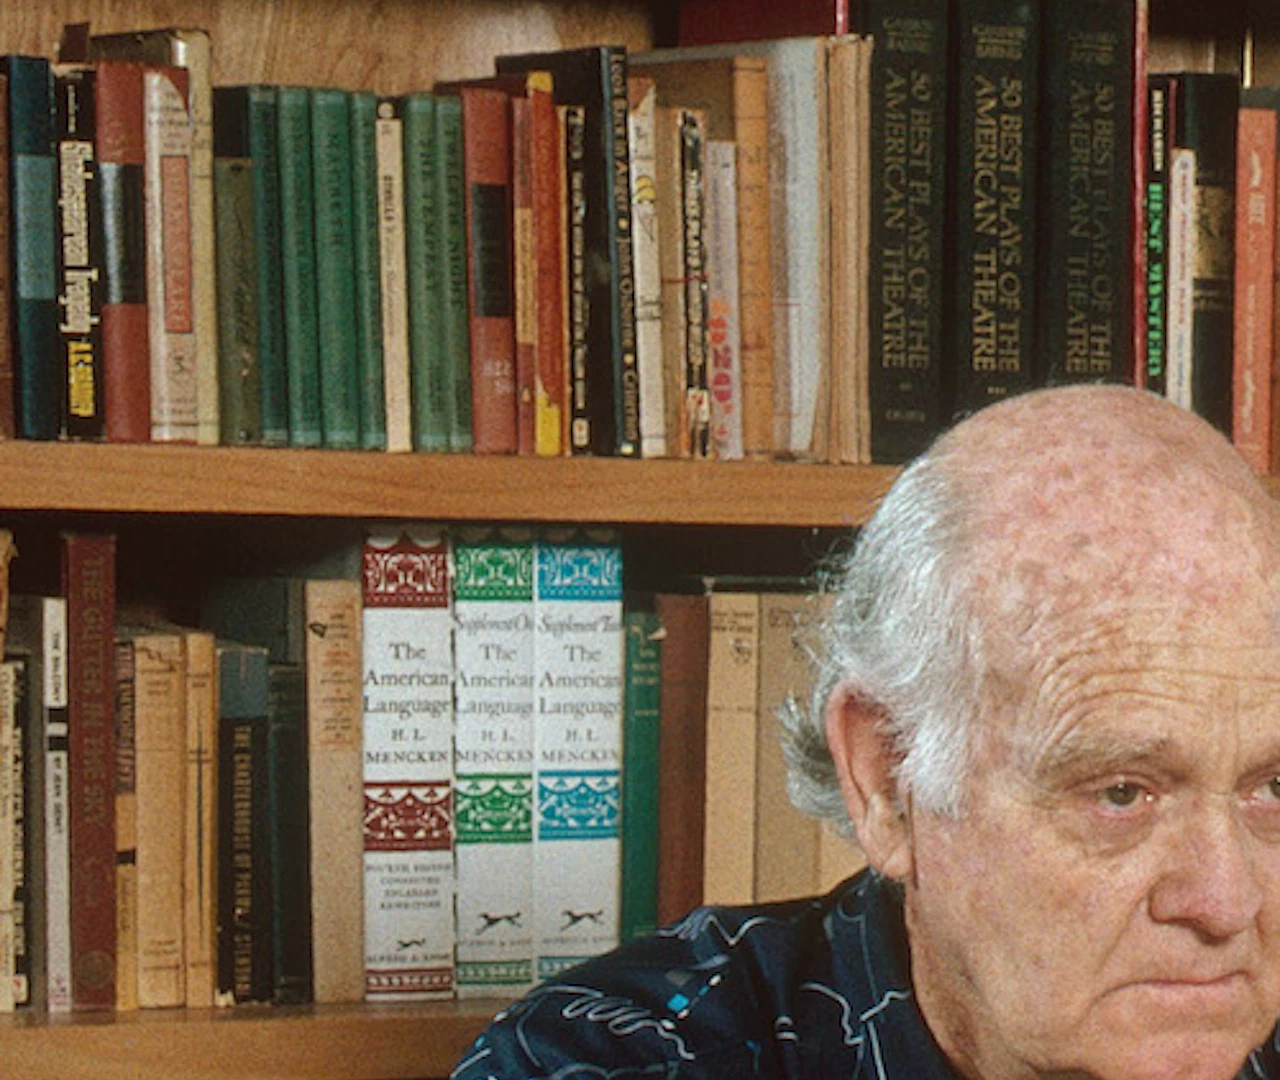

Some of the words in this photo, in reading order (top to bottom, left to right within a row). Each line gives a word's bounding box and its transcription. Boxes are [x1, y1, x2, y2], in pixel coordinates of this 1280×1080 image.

[610, 54, 626, 95] Look
[1000, 75, 1023, 107] 50
[612, 98, 629, 134] Back
[909, 108, 931, 174] BEST
[615, 138, 629, 156] in
[884, 67, 907, 229] AMERICAN
[973, 74, 998, 234] AMERICAN
[999, 113, 1023, 178] BEST
[1069, 79, 1090, 237] AMERICAN
[1092, 118, 1115, 181] BEST
[58, 141, 93, 266] Shakespearean
[613, 159, 629, 212] Anger
[908, 181, 930, 261] PLAYS
[999, 184, 1022, 267] PLAYS
[616, 236, 632, 272] John
[59, 267, 98, 333] Tragedy
[882, 246, 906, 368] THEATRE
[908, 268, 930, 307] OF
[972, 247, 996, 372] THEATRE
[998, 272, 1021, 309] OF
[1091, 273, 1112, 313] OF
[619, 279, 636, 348] Osborne
[1066, 256, 1089, 373] THEATRE
[1147, 264, 1165, 377] MYSTERY
[908, 318, 930, 369] THE
[998, 318, 1020, 372] THE
[1091, 321, 1111, 373] THE
[82, 554, 105, 601] THE
[83, 607, 105, 695] GUTTER
[537, 614, 596, 637] Supplement
[388, 642, 426, 661] The
[477, 643, 517, 661] The
[563, 643, 601, 661] The
[364, 669, 449, 687] American
[84, 701, 105, 727] IN
[363, 695, 450, 721] Language
[84, 733, 106, 773] THE
[233, 726, 253, 750] THE
[365, 750, 449, 764] MENCKEN
[84, 785, 106, 826] SKY
[232, 754, 253, 849] CHARTERHOUSE
